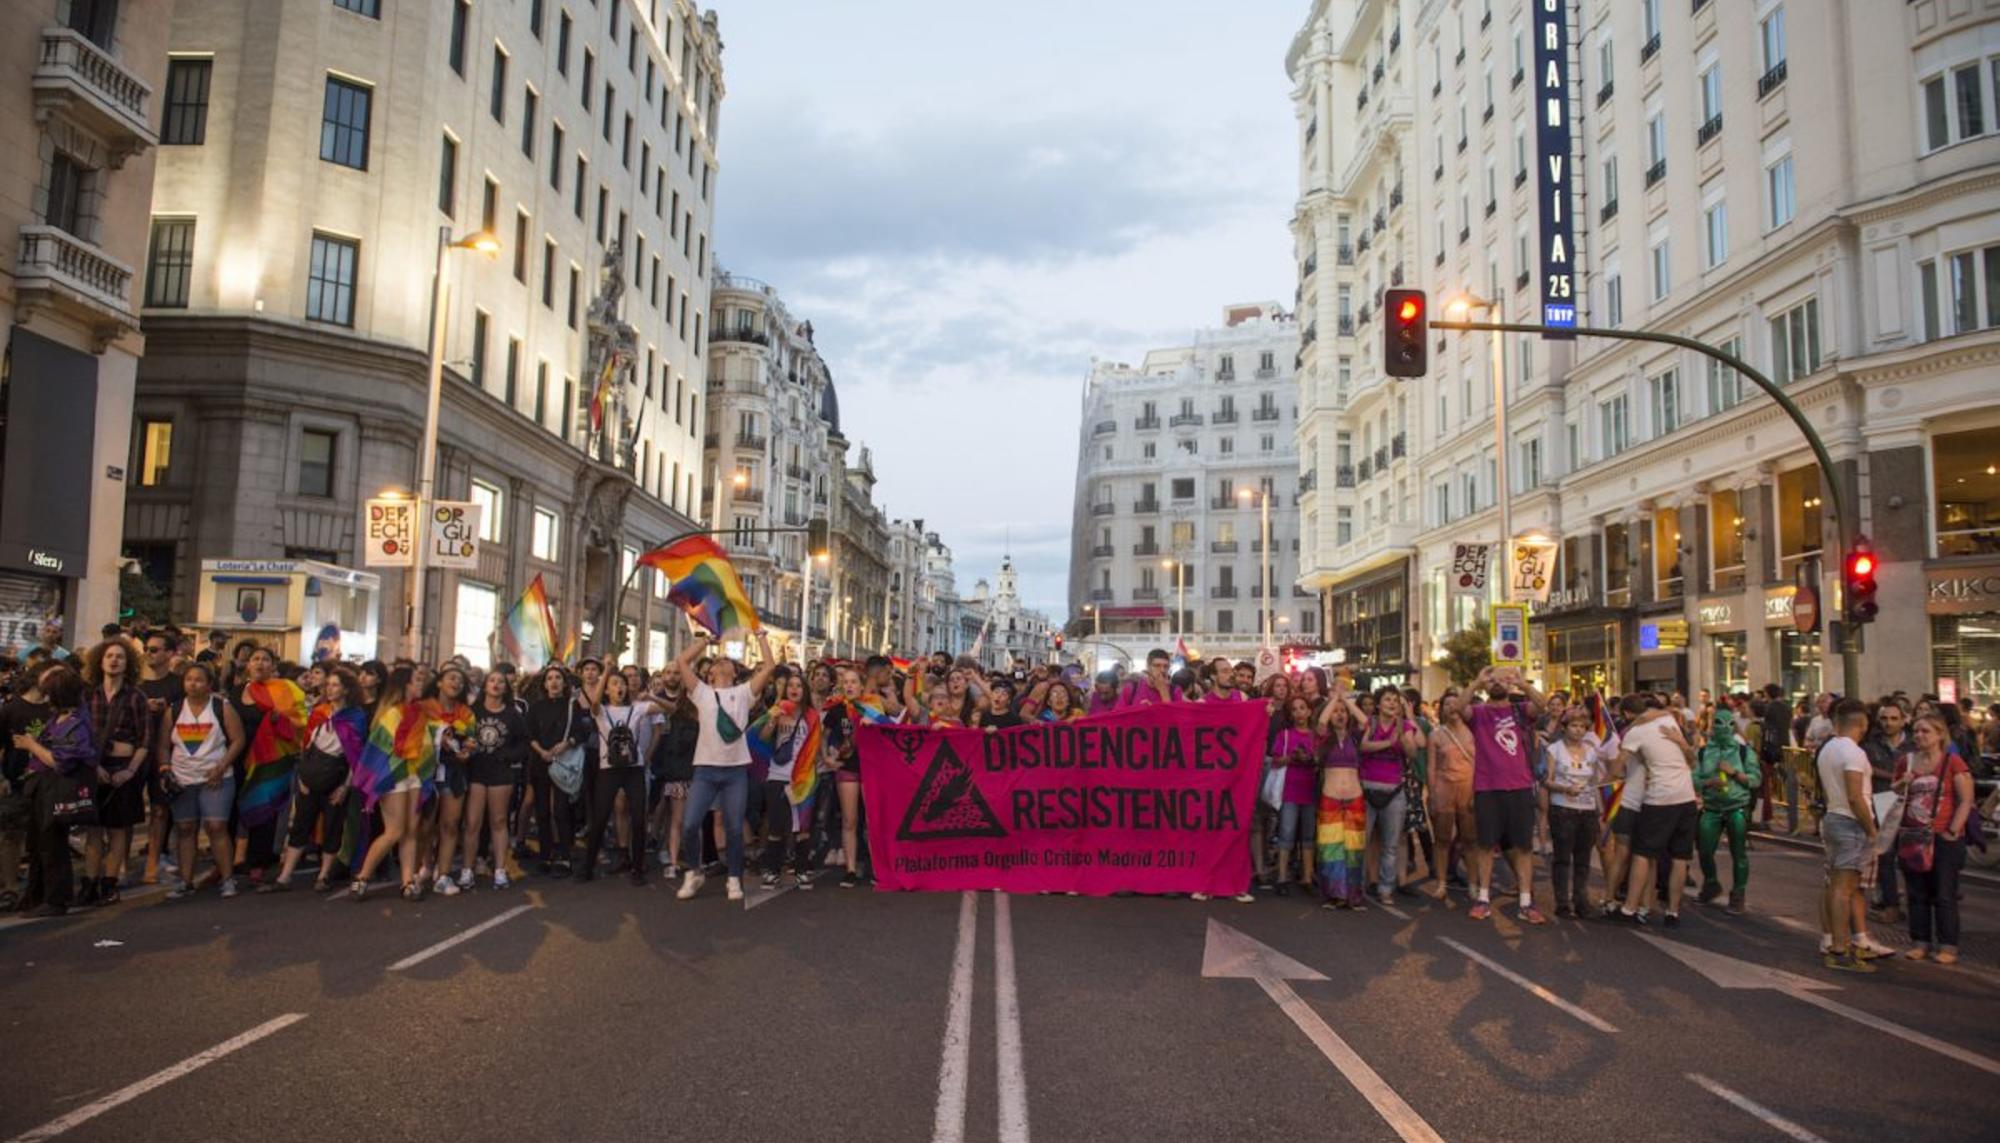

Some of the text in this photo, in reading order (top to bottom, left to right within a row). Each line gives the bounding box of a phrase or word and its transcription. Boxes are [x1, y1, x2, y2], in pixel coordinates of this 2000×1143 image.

[1549, 275, 1571, 298] 25
[984, 726, 1239, 772] DISIDENCIA ES
[1012, 784, 1239, 831] RESISTENCIA
[895, 852, 979, 874] Plataforma
[984, 849, 1038, 872] Orgullo
[1098, 848, 1152, 868] Madrid
